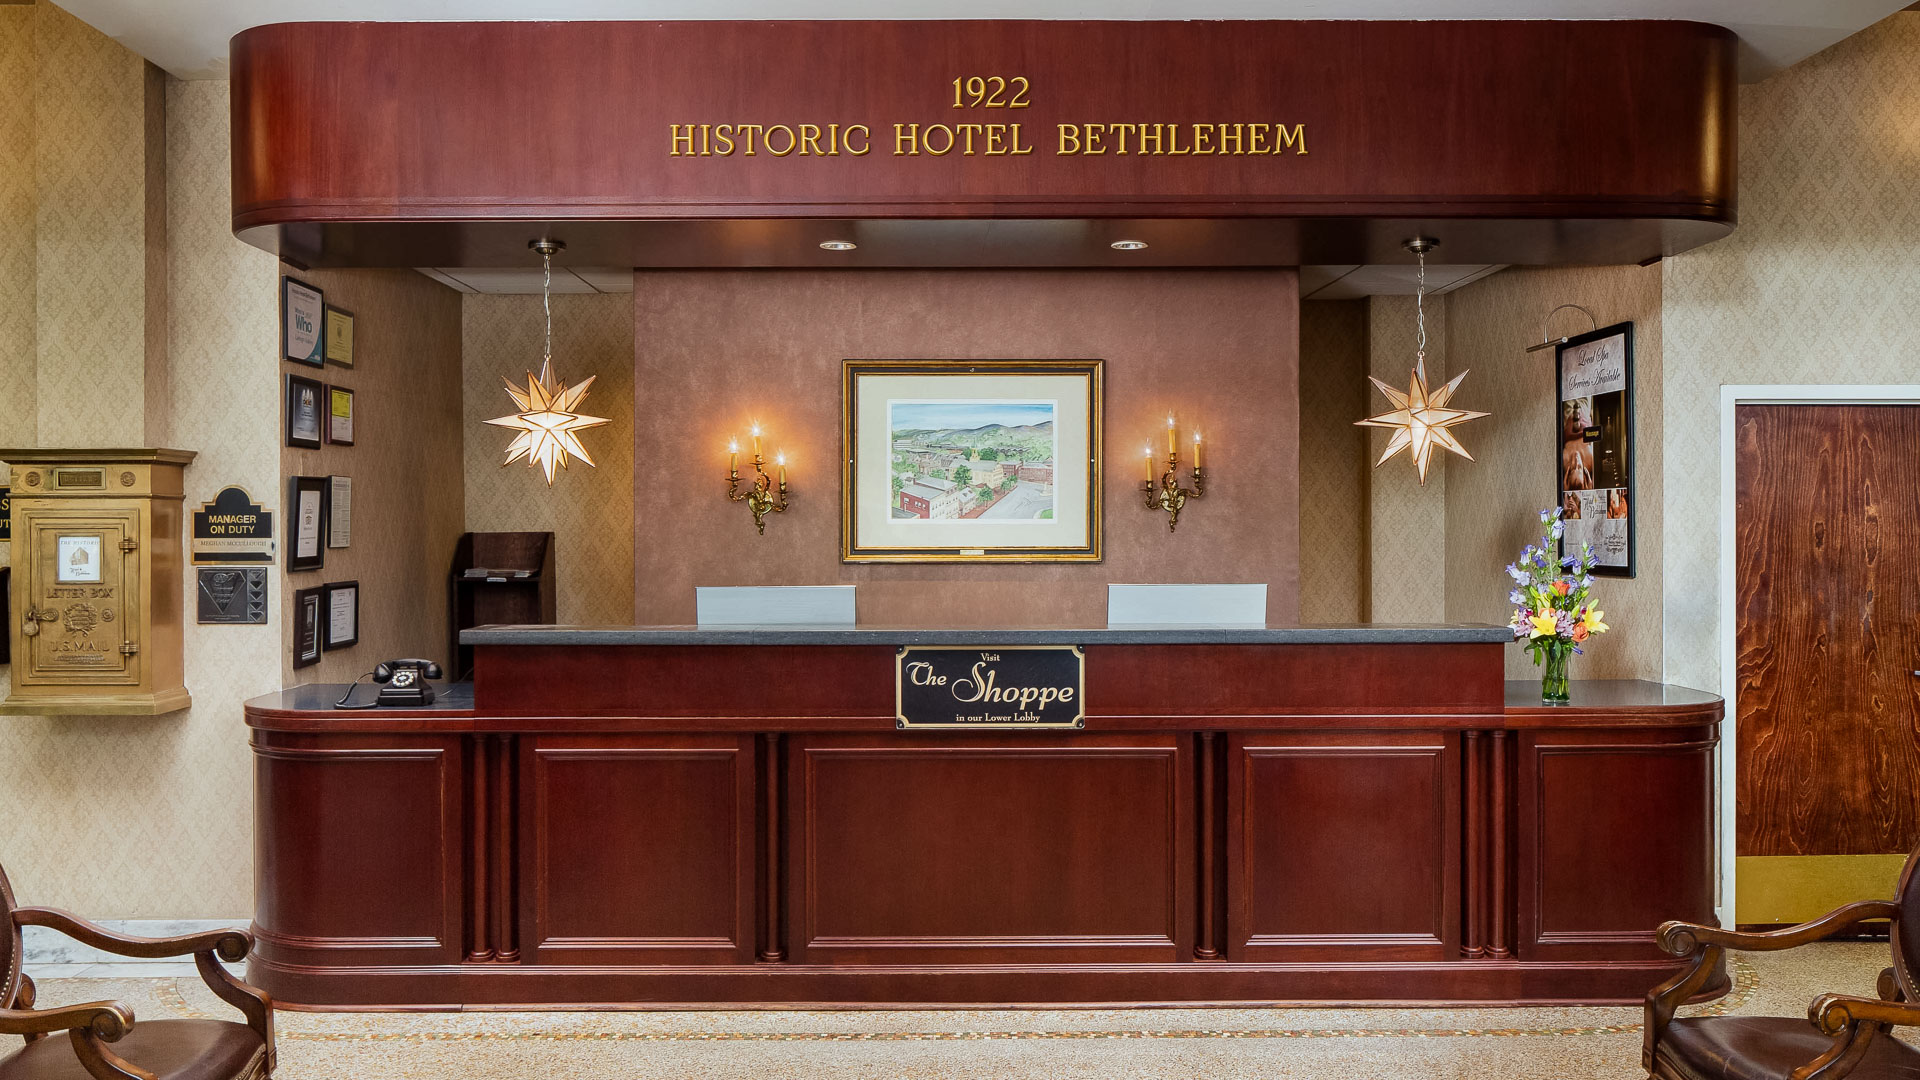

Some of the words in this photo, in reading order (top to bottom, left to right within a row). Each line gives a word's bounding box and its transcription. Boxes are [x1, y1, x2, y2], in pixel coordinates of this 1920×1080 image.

[953, 77, 1031, 109] 1922
[669, 123, 870, 158] HISTORIC
[893, 123, 1033, 156] HOTEL
[1057, 123, 1309, 157] BETHLEHEM
[208, 514, 257, 524] MANAGER
[210, 525, 225, 534] ON
[228, 525, 255, 534] DUTY
[90, 588, 114, 599] BOX
[980, 652, 1001, 662] Visit
[906, 661, 947, 686] The
[951, 661, 1074, 711] Shoppe
[955, 713, 965, 722] in
[984, 712, 1012, 722] Lower
[1013, 711, 1041, 724] Lobby
